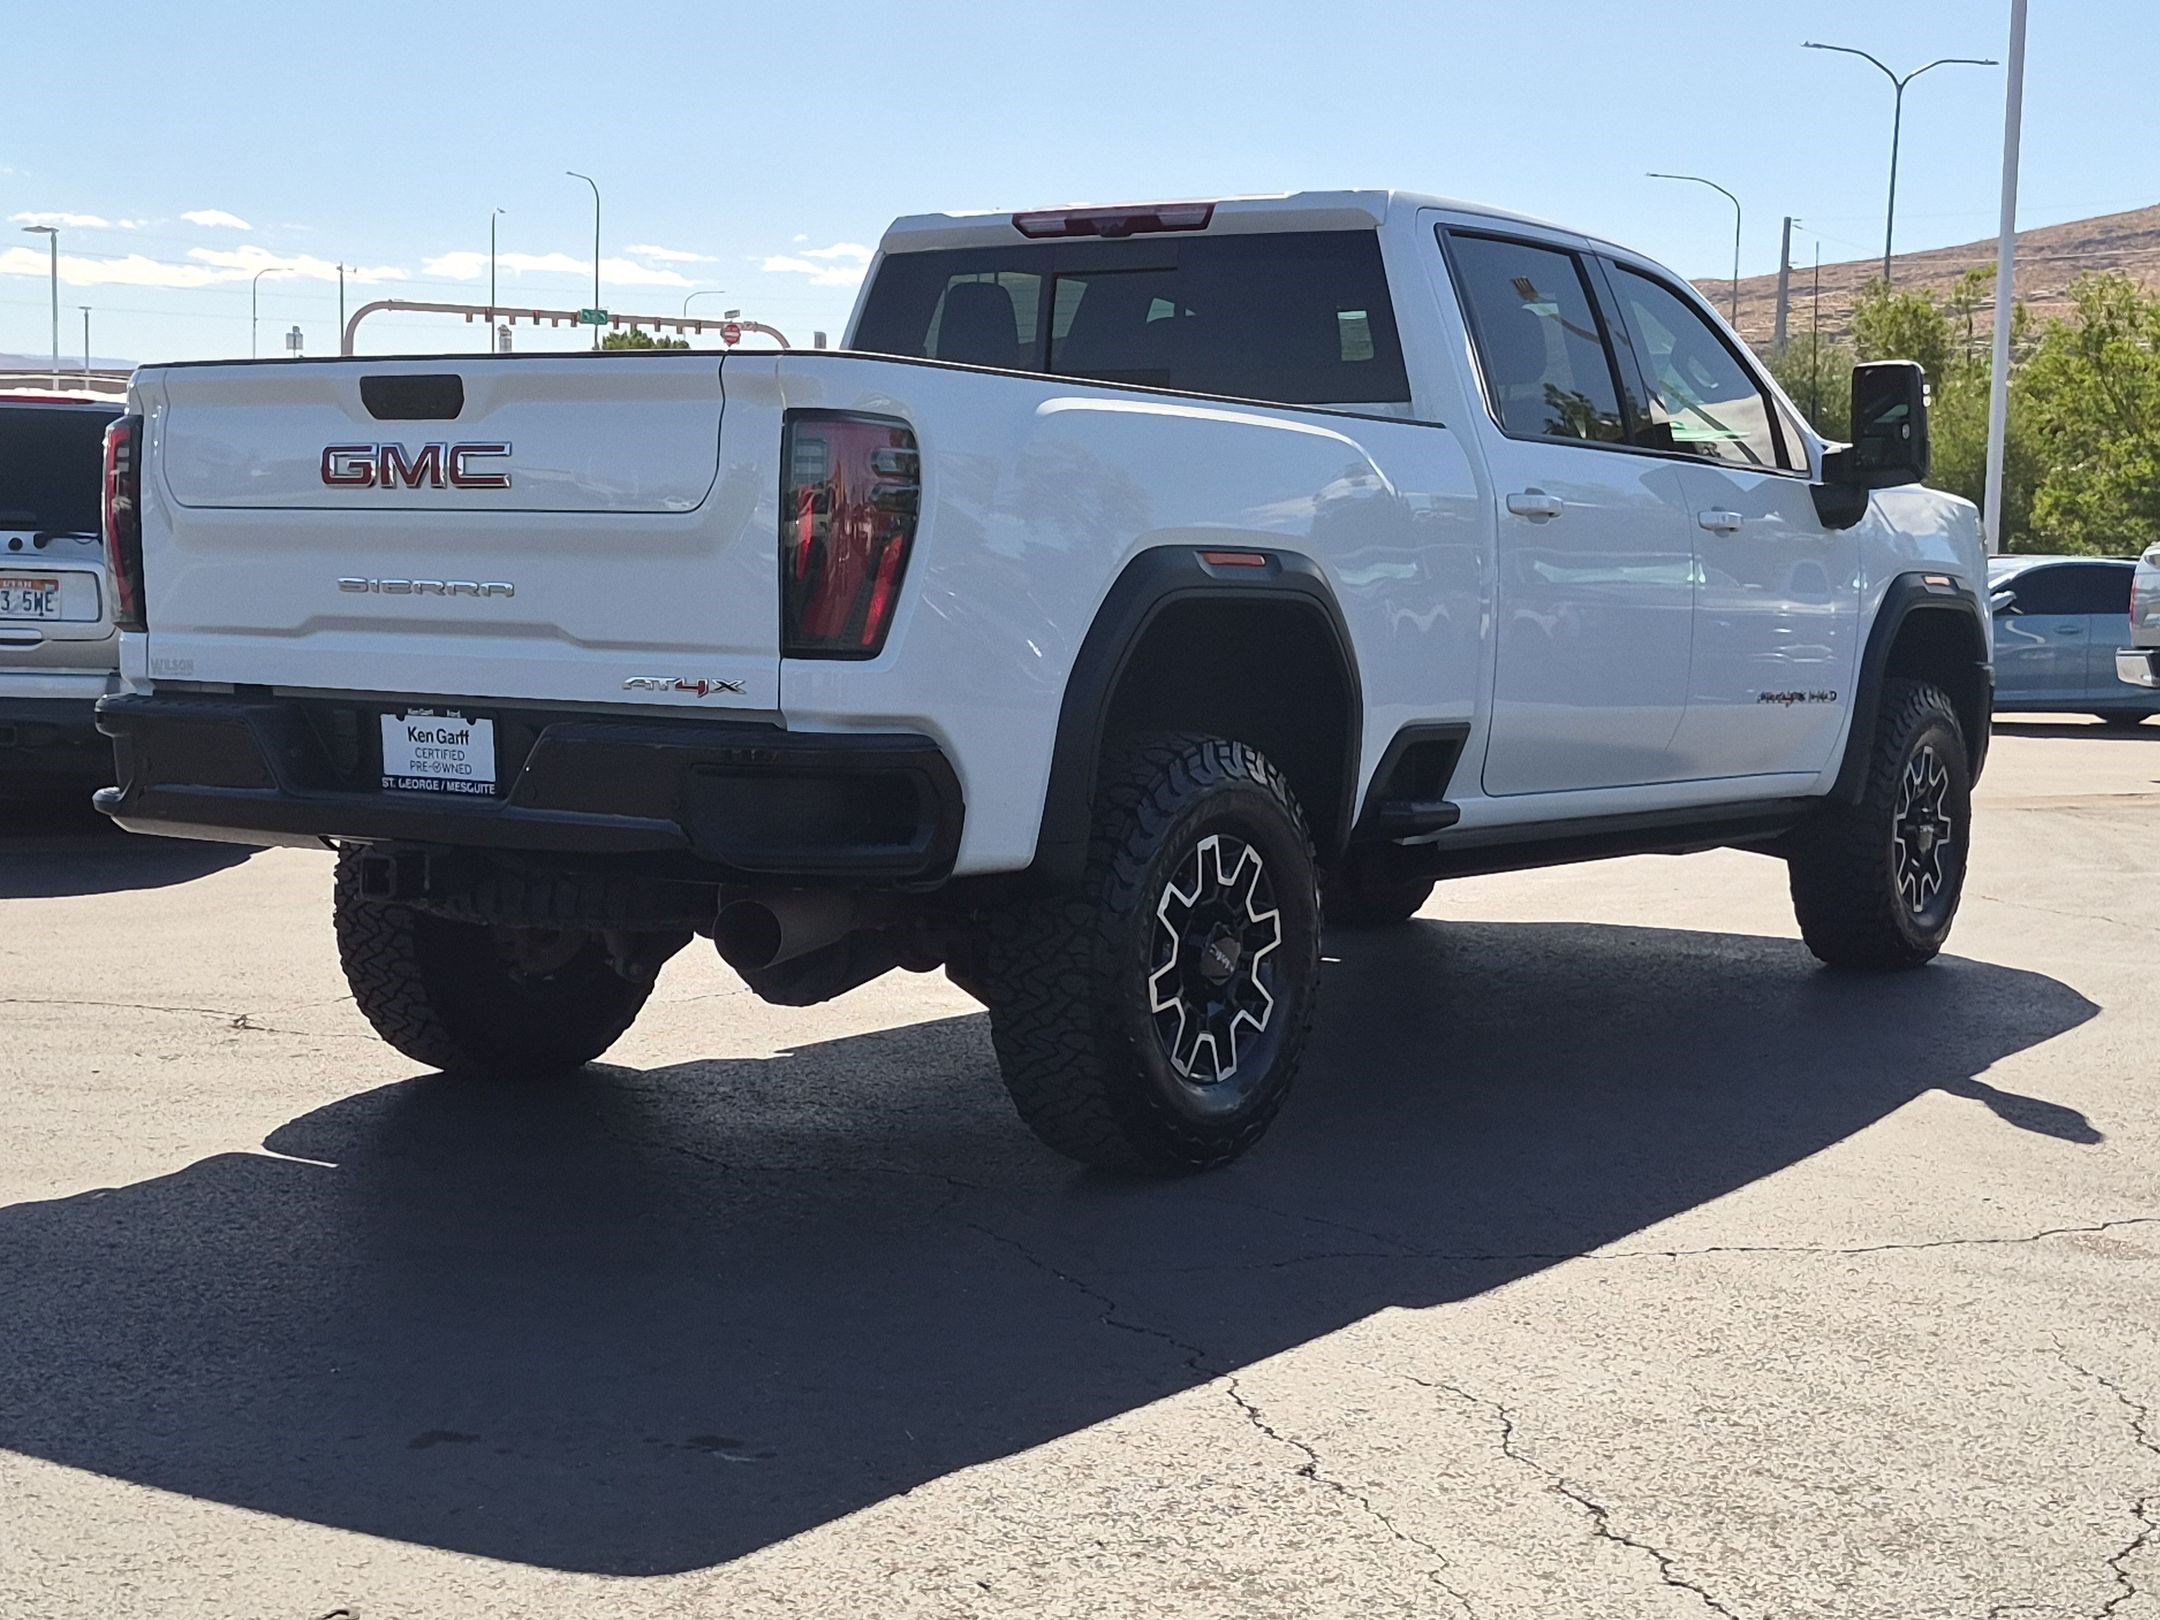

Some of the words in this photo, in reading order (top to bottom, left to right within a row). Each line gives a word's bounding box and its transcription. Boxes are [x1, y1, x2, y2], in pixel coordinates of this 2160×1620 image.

[321, 442, 512, 489] GMC
[337, 577, 515, 597] SIERRA
[622, 676, 746, 698] AT4X
[407, 726, 434, 743] Ken
[436, 728, 470, 746] Garff
[415, 747, 465, 761] CERTIFIED
[381, 777, 396, 789] ST.
[398, 778, 439, 791] GEORGE
[446, 781, 495, 795] MESQUITE
